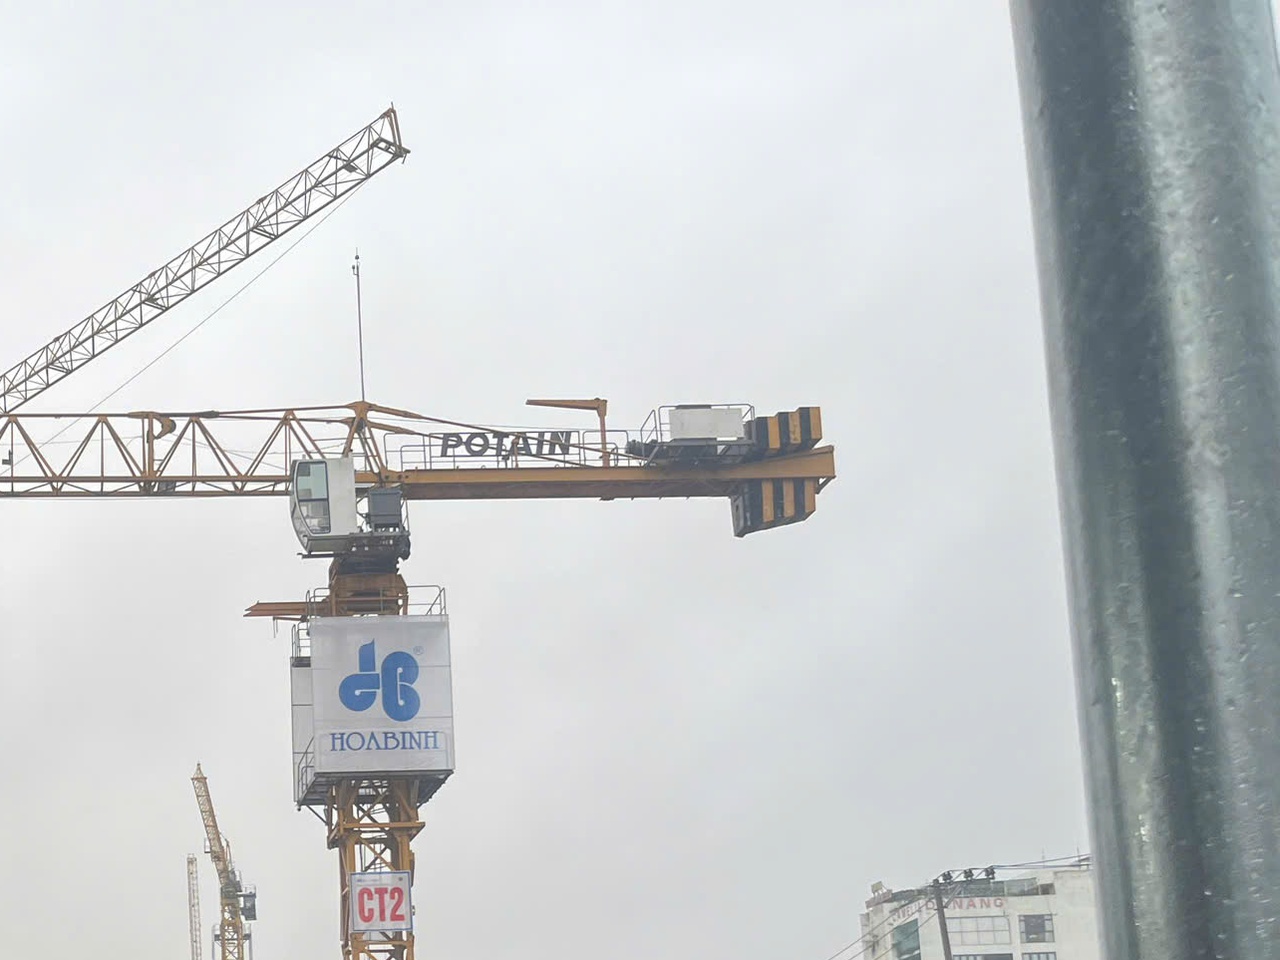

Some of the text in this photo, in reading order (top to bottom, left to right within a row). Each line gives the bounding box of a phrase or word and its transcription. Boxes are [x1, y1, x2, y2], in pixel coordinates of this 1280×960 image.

[440, 431, 570, 457] POTAIN
[330, 731, 439, 752] HOABINH
[357, 886, 406, 923] CT2
